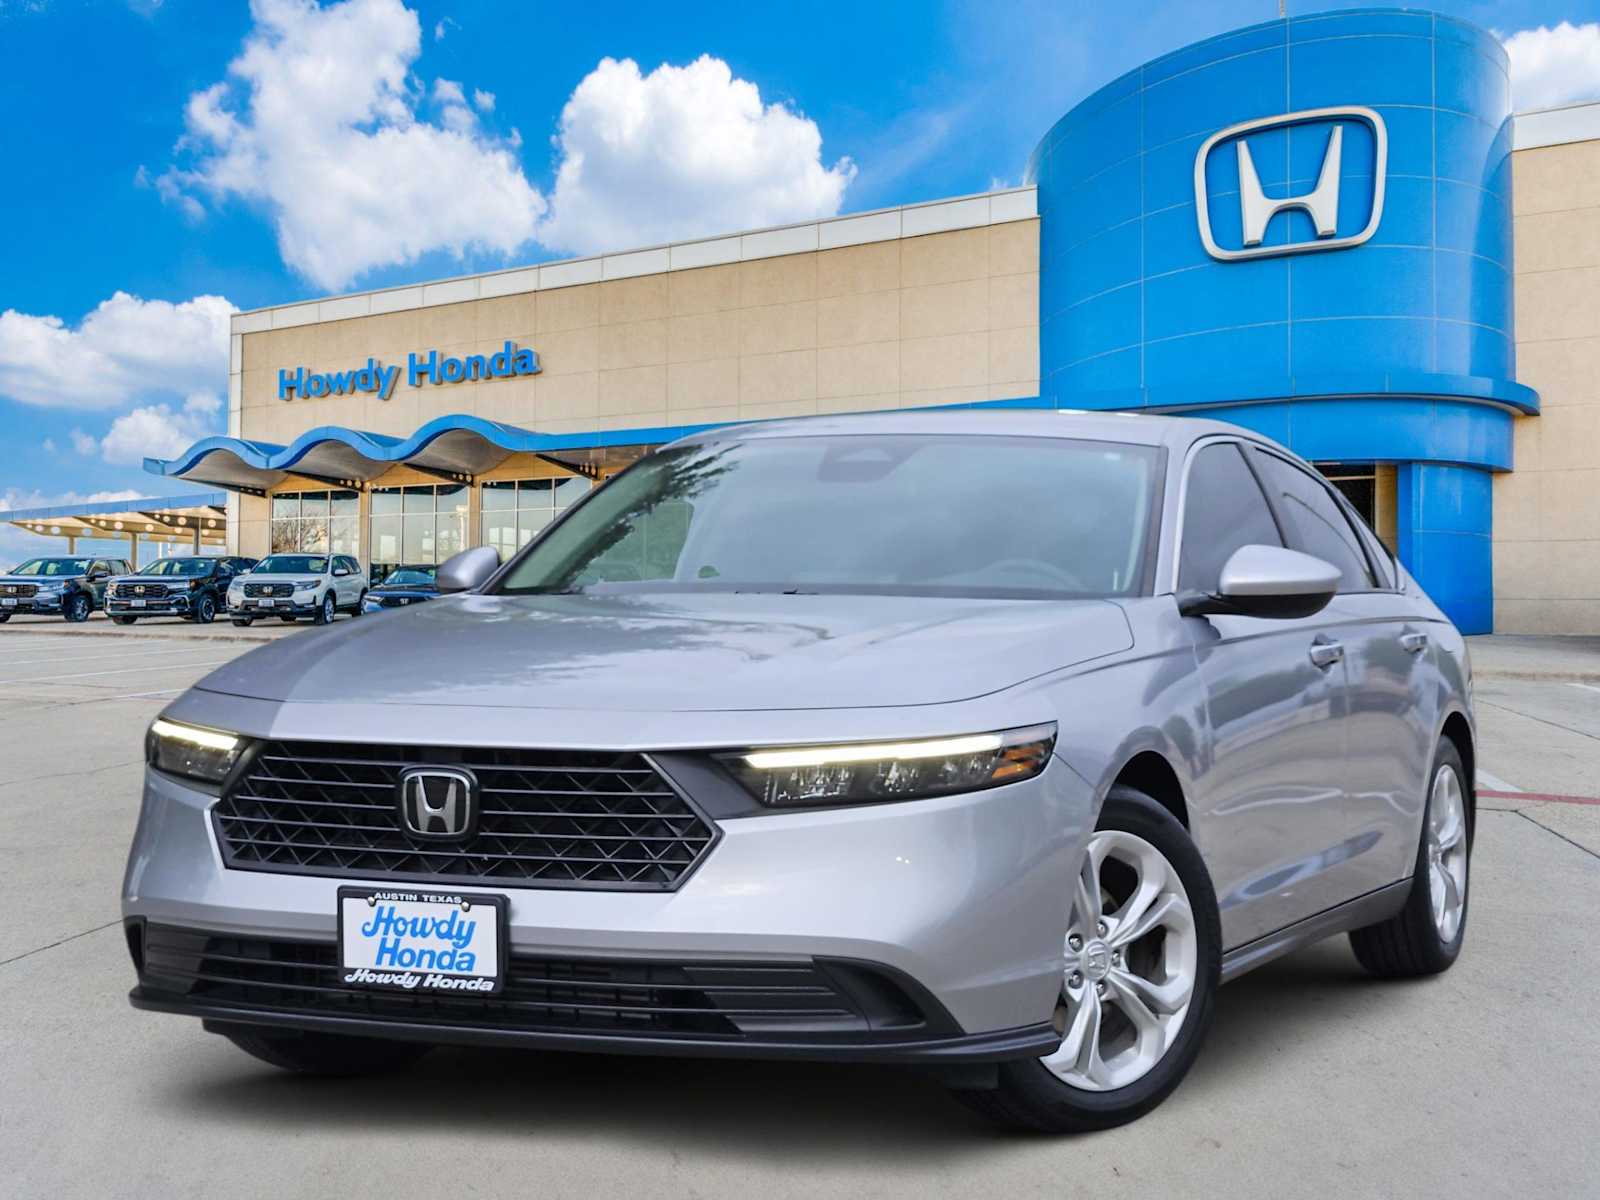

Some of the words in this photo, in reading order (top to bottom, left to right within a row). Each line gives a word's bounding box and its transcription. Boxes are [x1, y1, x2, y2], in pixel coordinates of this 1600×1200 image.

[278, 357, 401, 401] Howdy
[408, 340, 543, 388] Honda
[374, 891, 418, 902] AUSTIN
[422, 893, 463, 905] TEXAS
[361, 905, 477, 950] Howdy
[375, 936, 477, 973] Honda
[343, 968, 423, 989] Howdy
[423, 973, 495, 992] Honda
